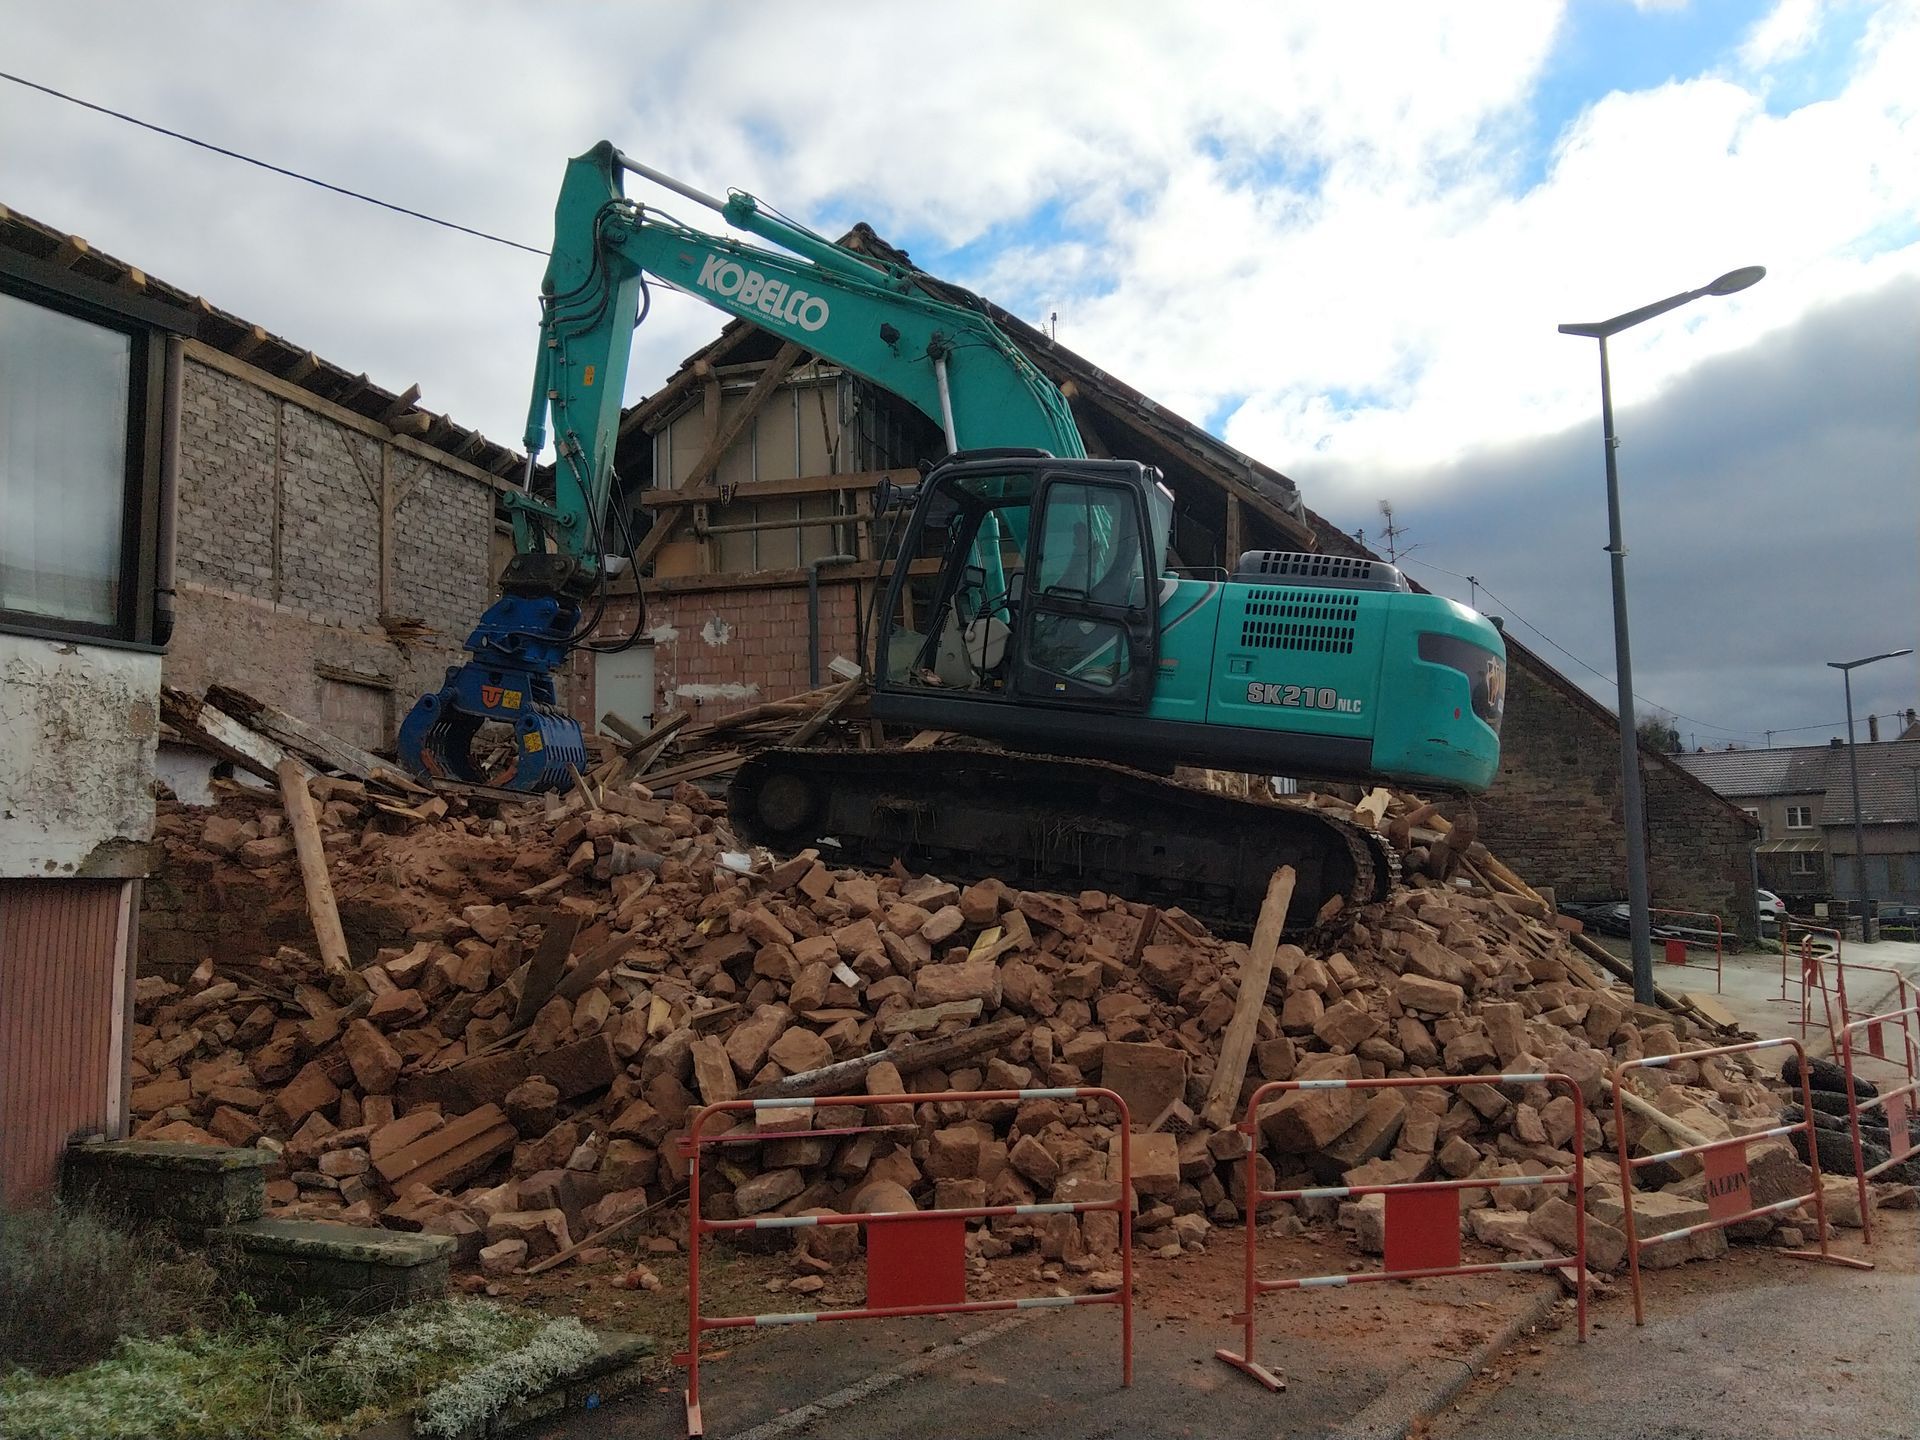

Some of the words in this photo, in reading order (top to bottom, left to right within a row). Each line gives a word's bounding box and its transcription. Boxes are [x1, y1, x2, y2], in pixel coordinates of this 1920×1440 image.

[697, 254, 829, 332] KOBELCO
[1247, 682, 1337, 710] SK210
[1337, 699, 1361, 713] NLC
